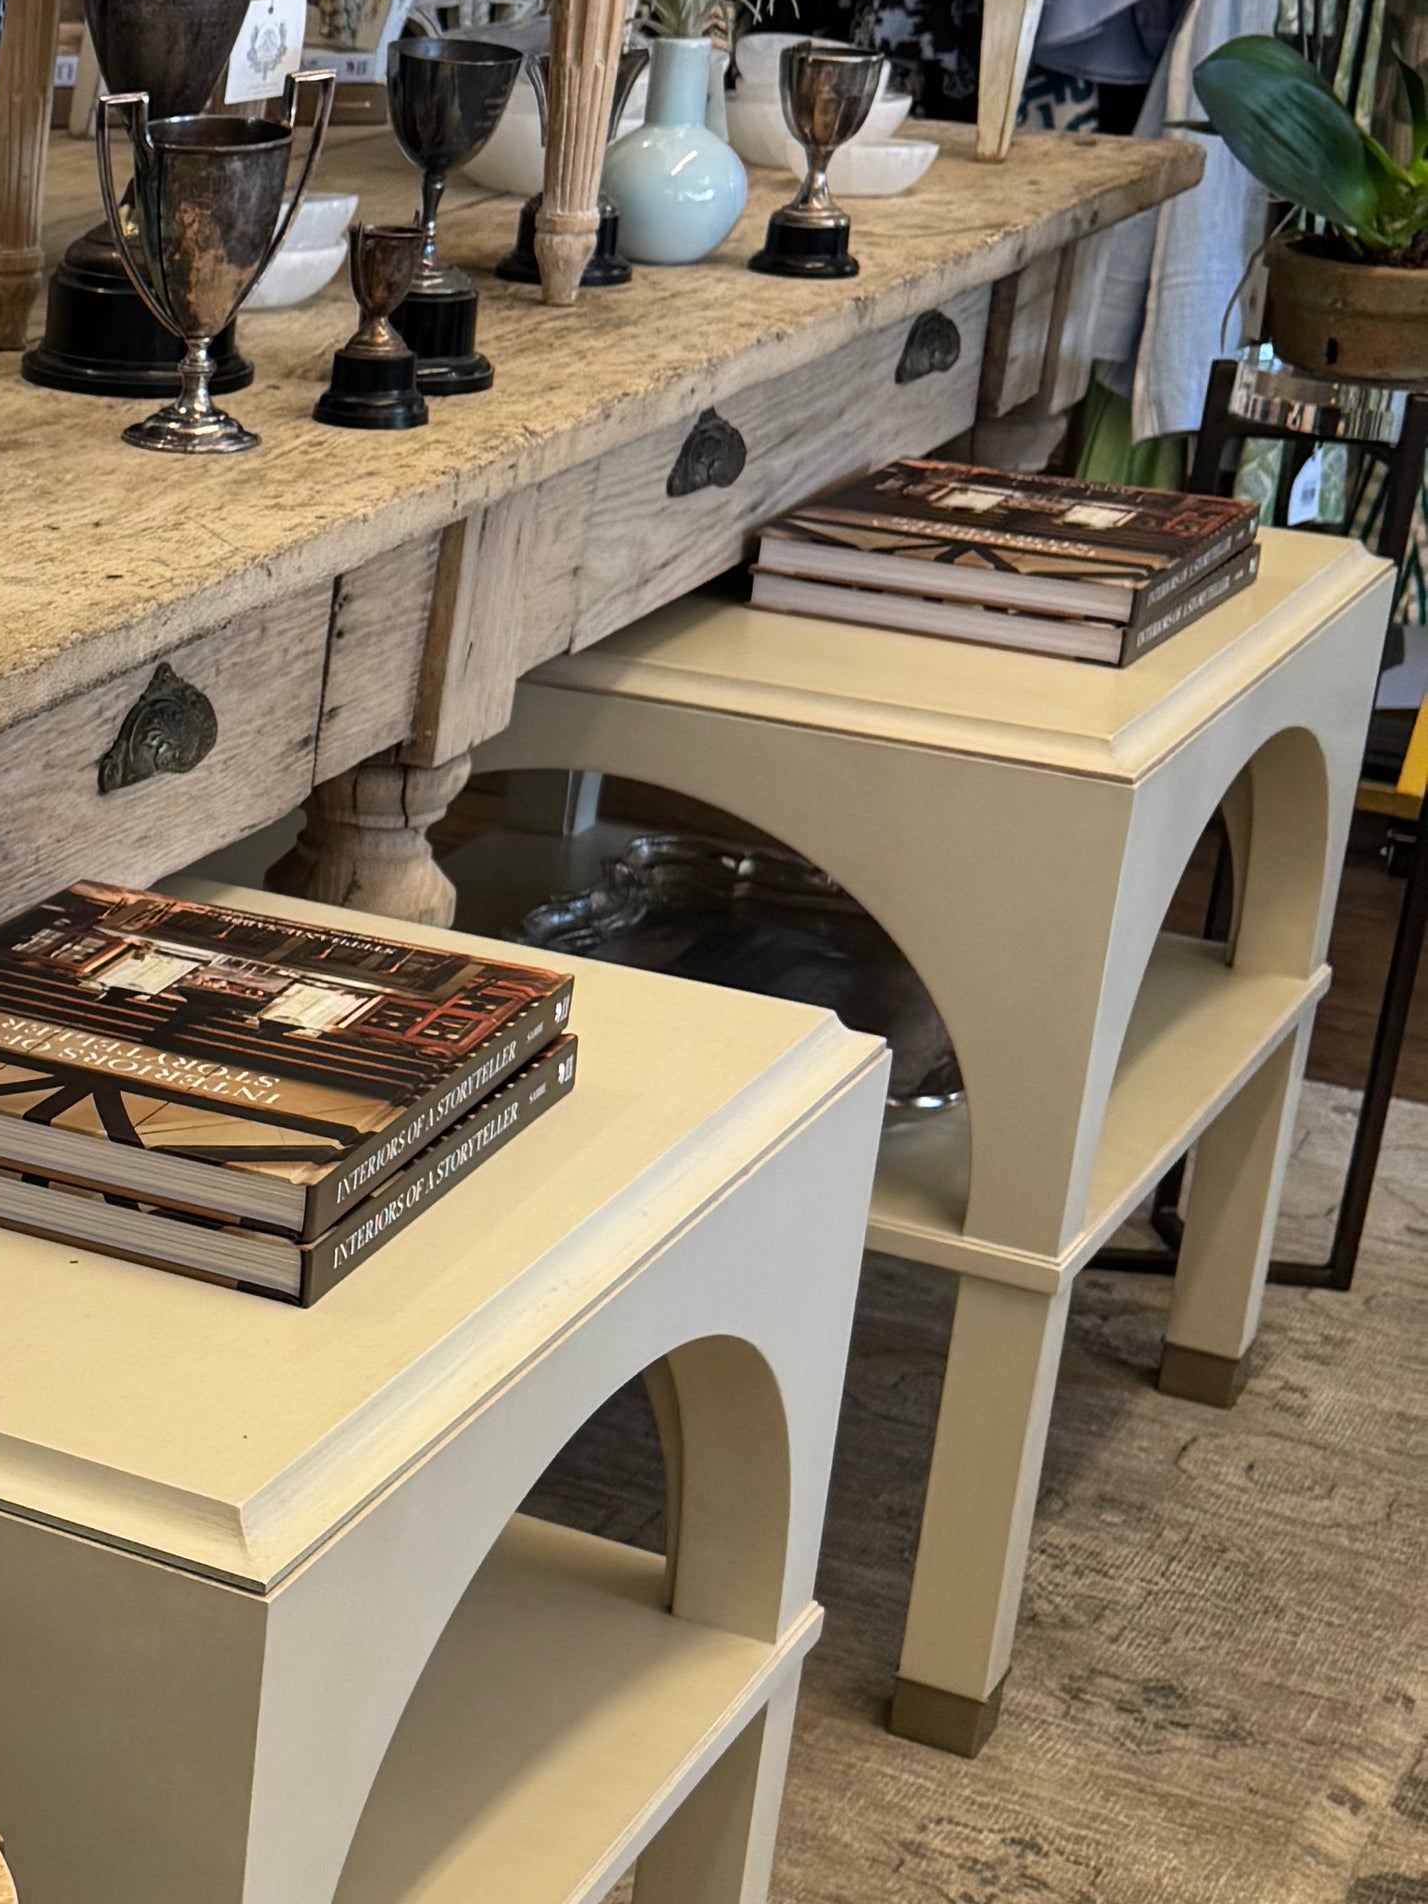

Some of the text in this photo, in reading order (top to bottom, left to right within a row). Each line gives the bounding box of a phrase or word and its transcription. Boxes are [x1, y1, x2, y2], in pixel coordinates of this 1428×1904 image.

[1, 1017, 280, 1088] STORYTELLER
[58, 1046, 280, 1105] INTERIORS
[337, 1129, 405, 1204] INTERIORS
[407, 1114, 425, 1145] OF
[425, 1108, 434, 1132] A
[436, 1041, 517, 1122] STORYTELLER
[333, 1192, 404, 1269] INTERIORS
[406, 1177, 424, 1208] OF
[425, 1170, 434, 1194] A
[435, 1101, 518, 1186] STORYTELLER
